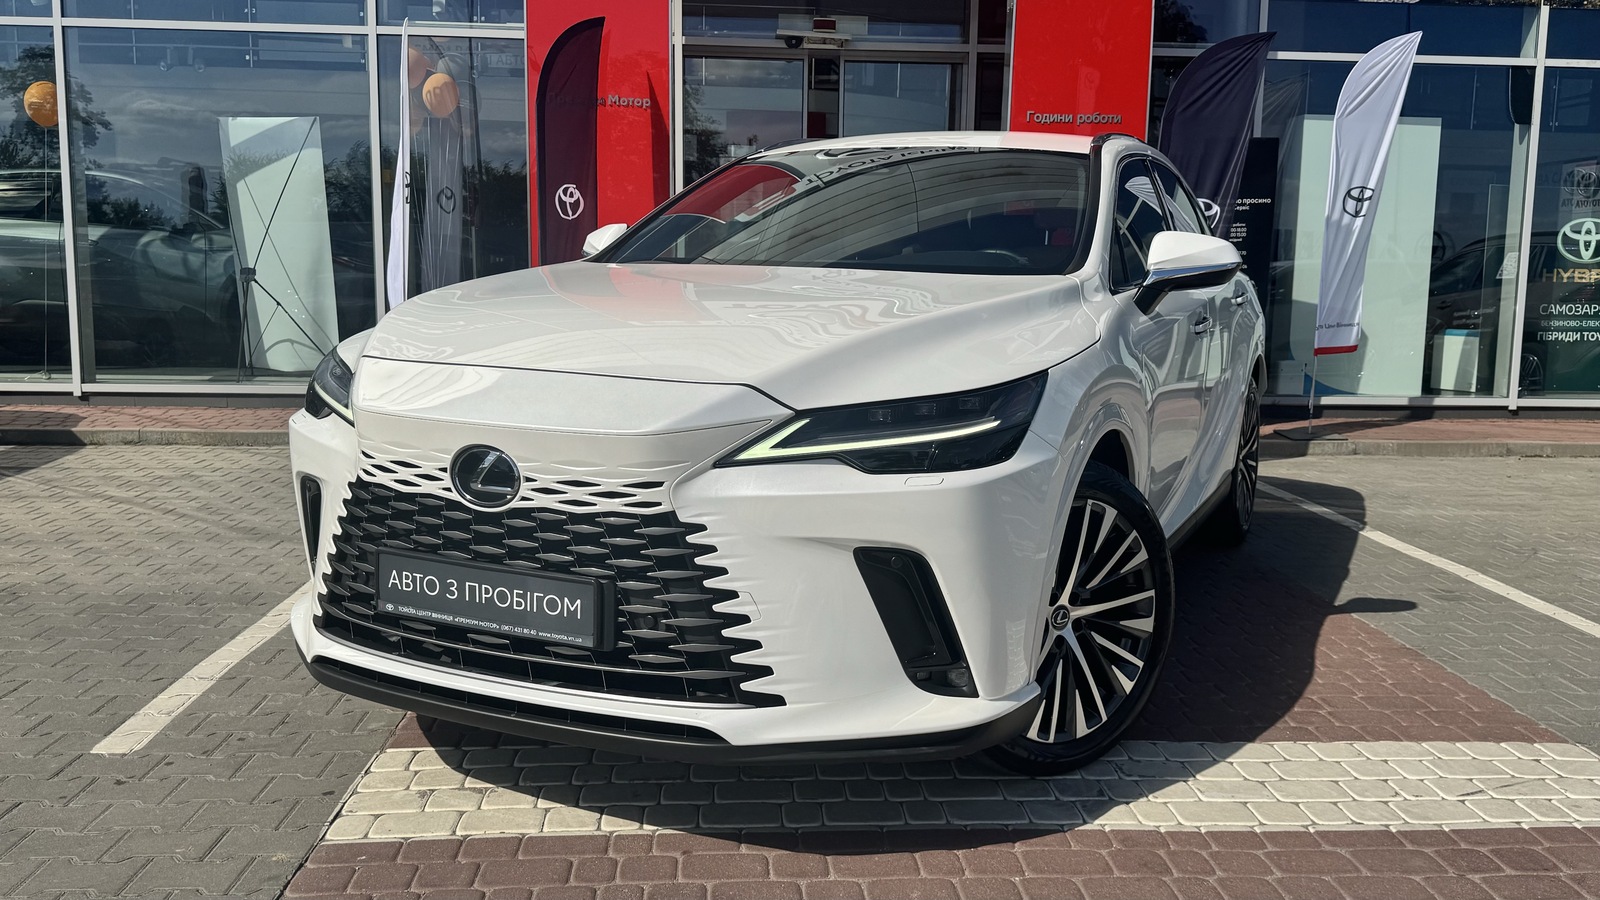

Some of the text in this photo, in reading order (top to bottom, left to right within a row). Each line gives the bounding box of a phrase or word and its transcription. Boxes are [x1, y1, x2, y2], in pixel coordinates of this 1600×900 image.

[607, 94, 651, 109] Мотор
[1026, 110, 1122, 125] Години роботи
[1540, 303, 1600, 316] САМОЗАР
[1537, 331, 1580, 342] ГІБРИДИ
[388, 569, 440, 596] АВТО
[465, 581, 581, 620] ПРОБІГОМ
[416, 609, 432, 617] ЦЕНТР
[432, 612, 453, 622] ВІННИЦЯ
[500, 624, 514, 634] (067)
[514, 627, 523, 635] 431
